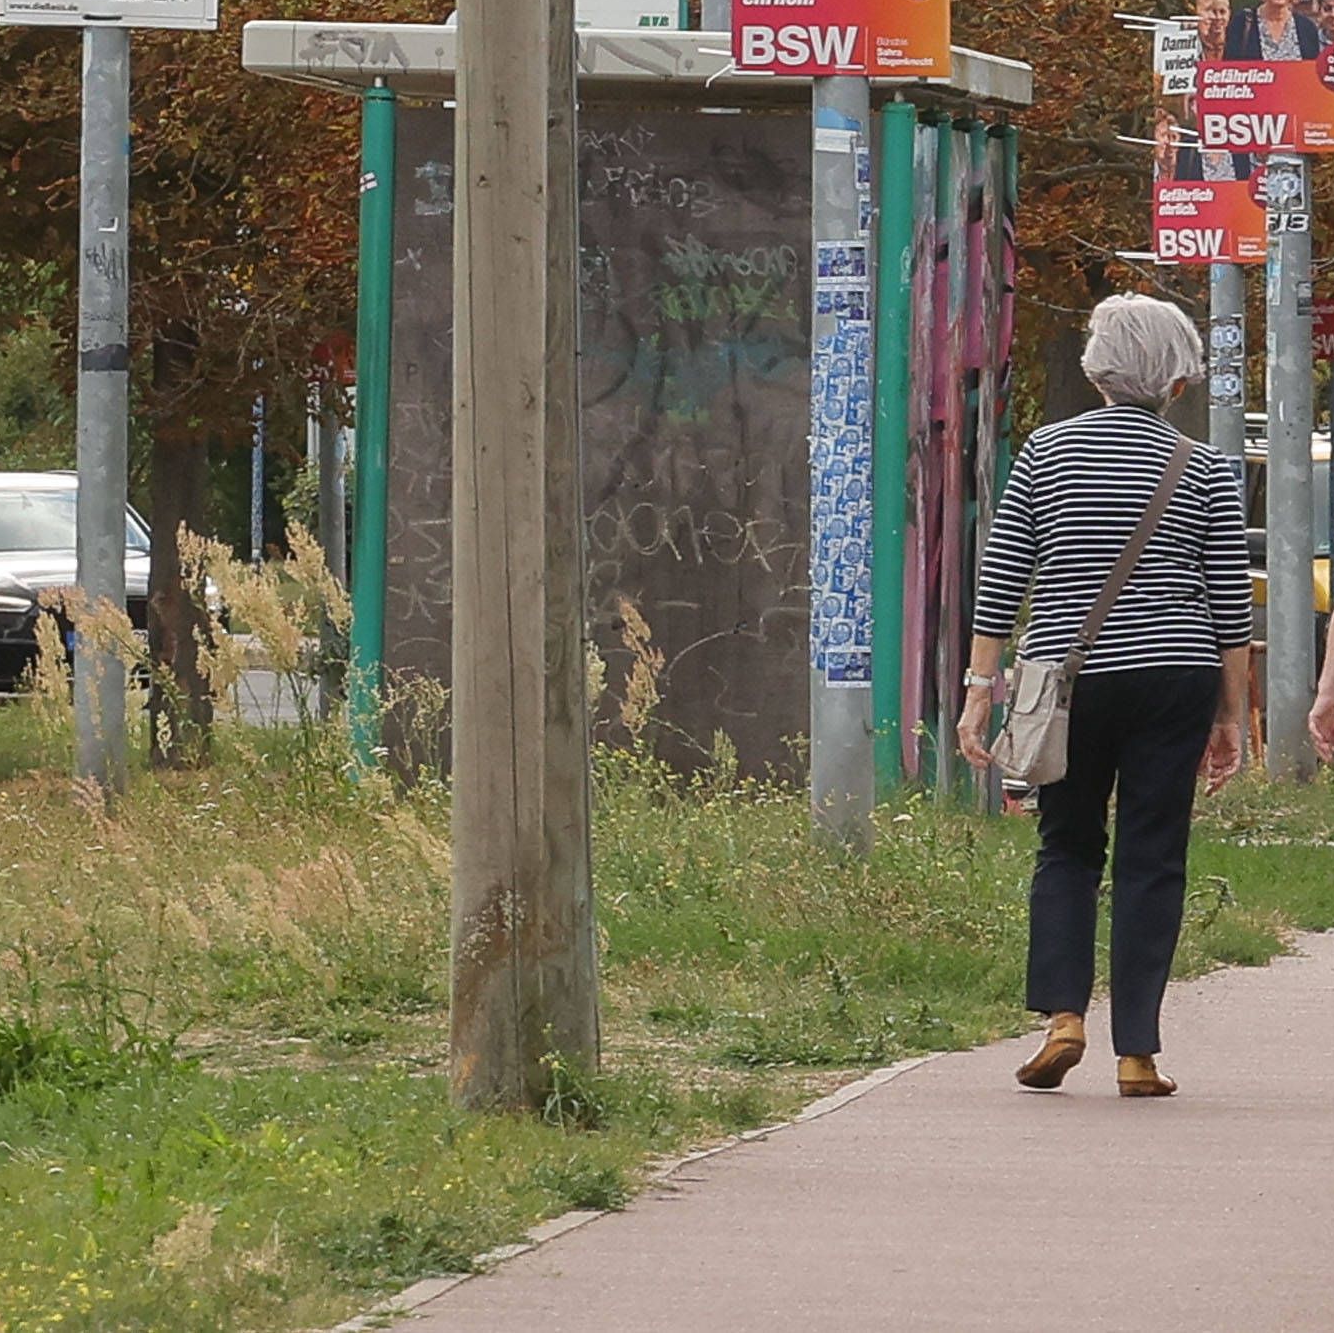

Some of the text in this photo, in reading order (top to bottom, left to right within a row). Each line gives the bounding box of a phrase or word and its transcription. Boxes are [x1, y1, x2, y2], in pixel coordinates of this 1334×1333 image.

[741, 25, 858, 66] BSW
[1161, 35, 1197, 52] Damit
[1168, 75, 1190, 90] des
[1203, 68, 1275, 85] Gefährlich
[1203, 84, 1255, 99] ehrlich.
[1203, 113, 1288, 146] BSW
[1158, 228, 1224, 258] BSW
